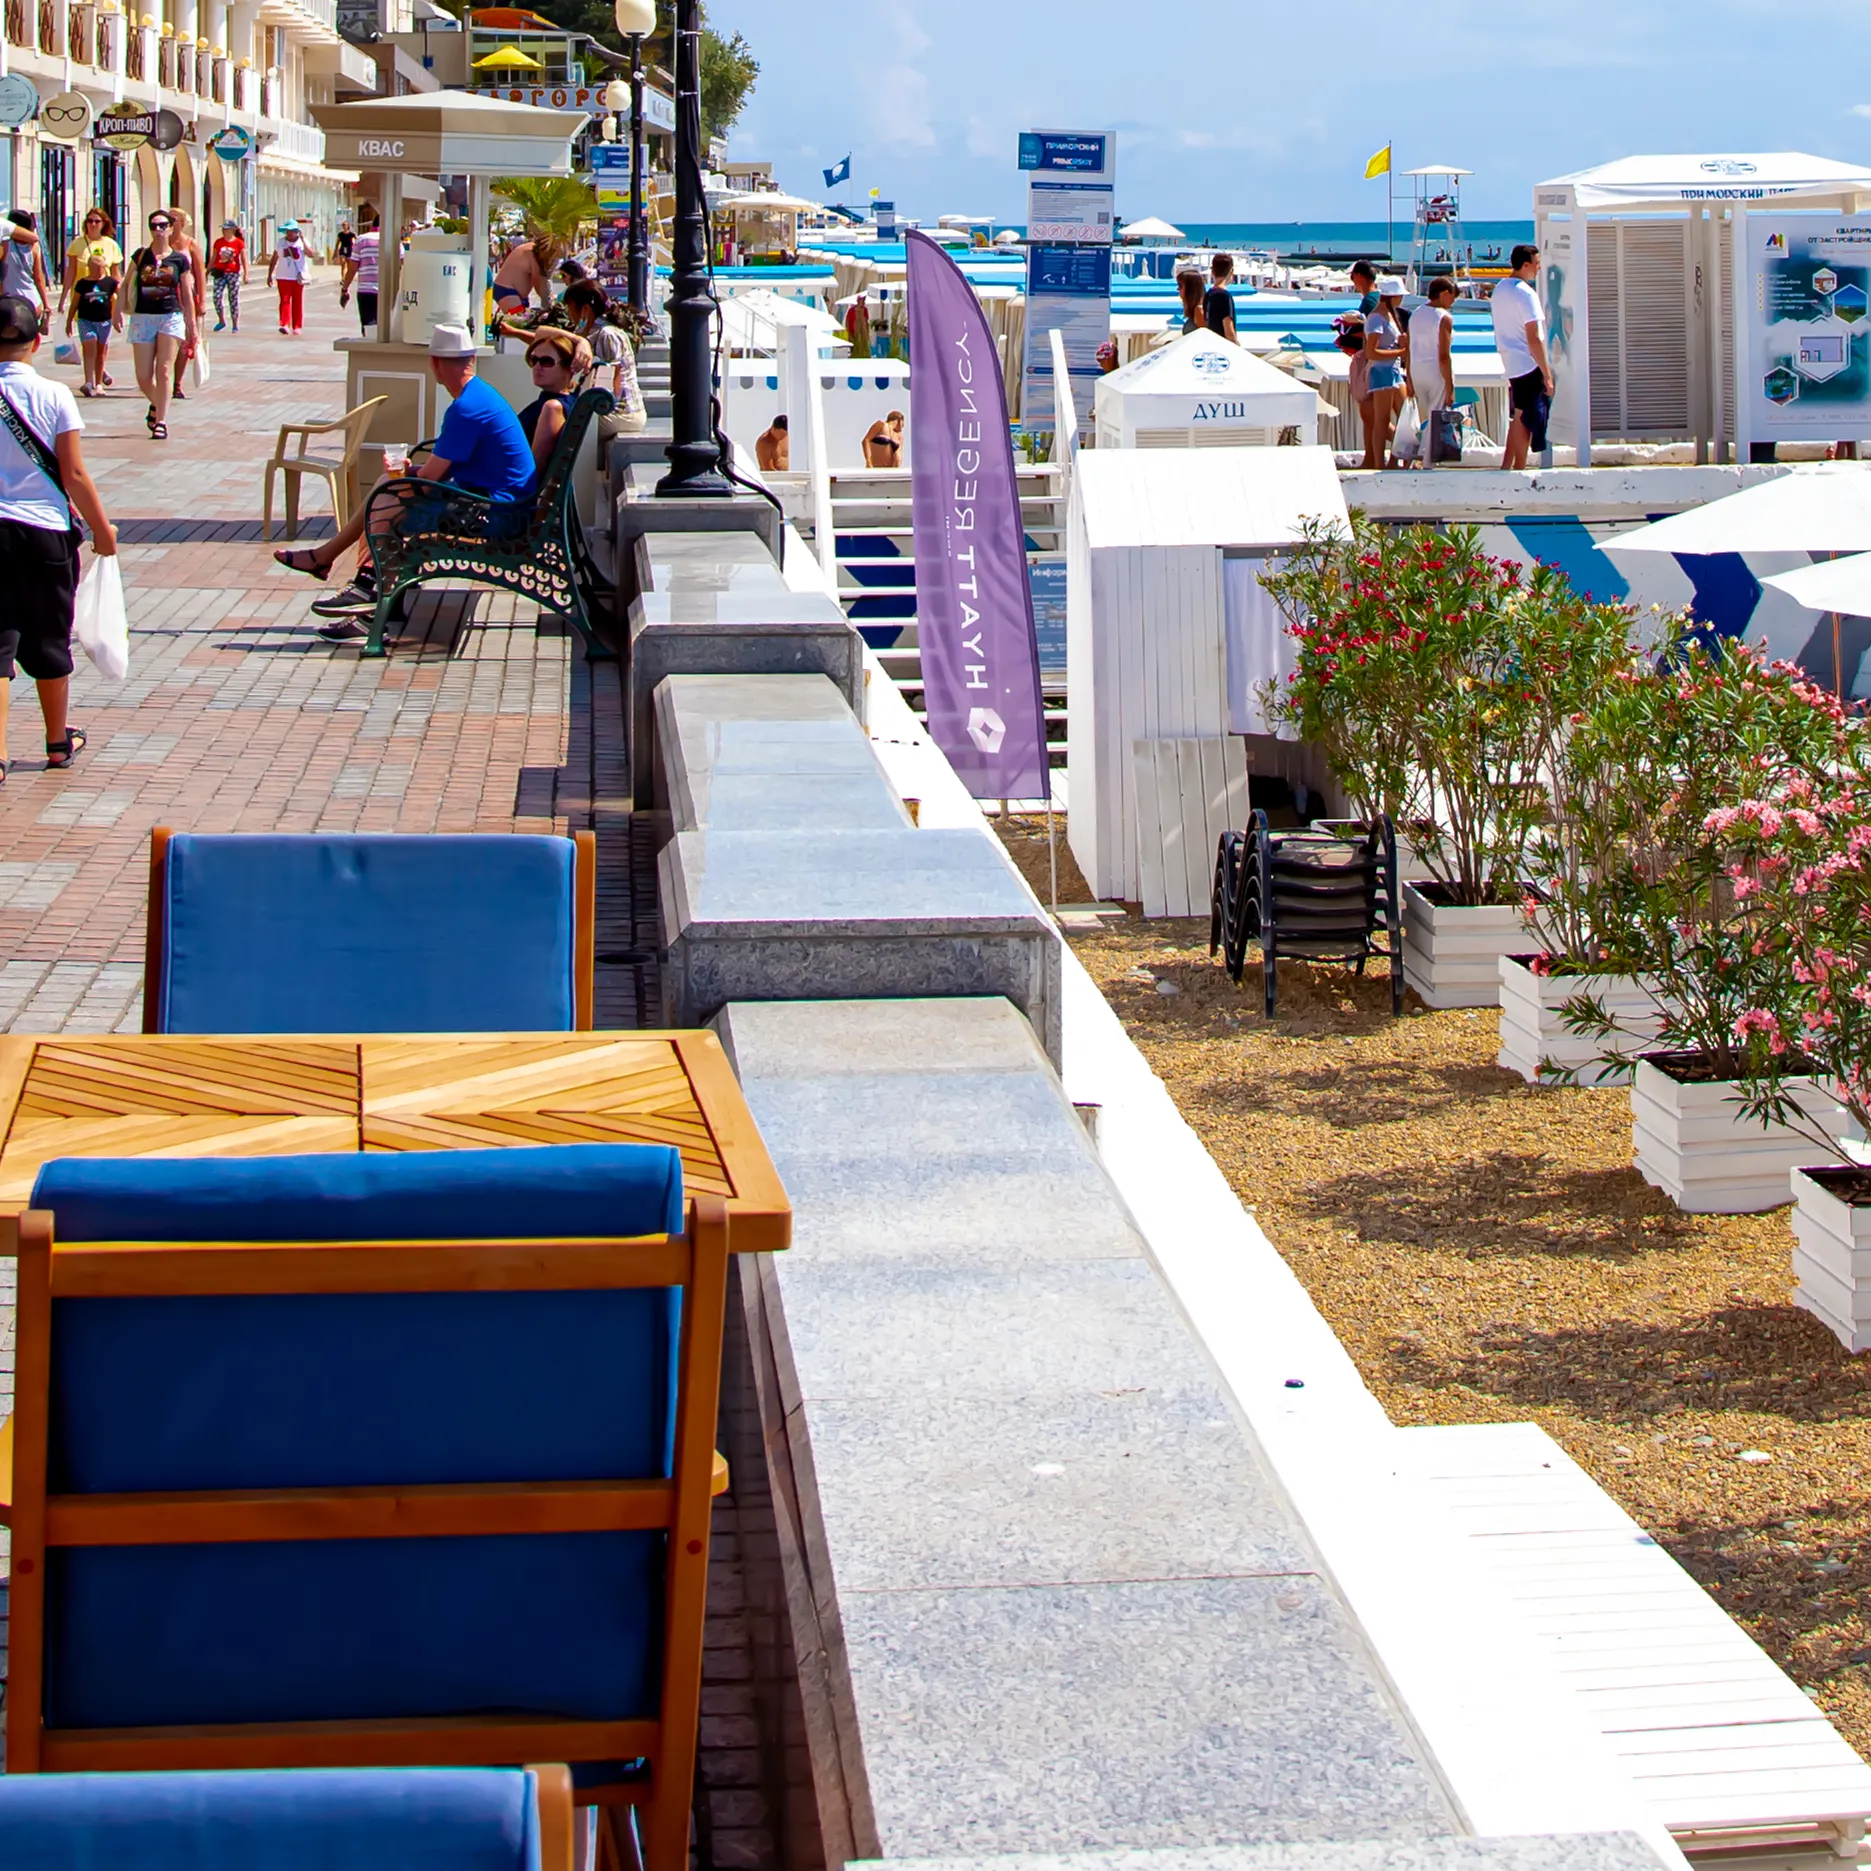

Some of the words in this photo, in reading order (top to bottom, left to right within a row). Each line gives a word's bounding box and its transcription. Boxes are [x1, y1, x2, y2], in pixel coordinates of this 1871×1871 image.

[358, 140, 405, 157] КВАС
[1680, 189, 1763, 199] ПРИМОРСКИЙ
[1193, 402, 1246, 420] ДУШ
